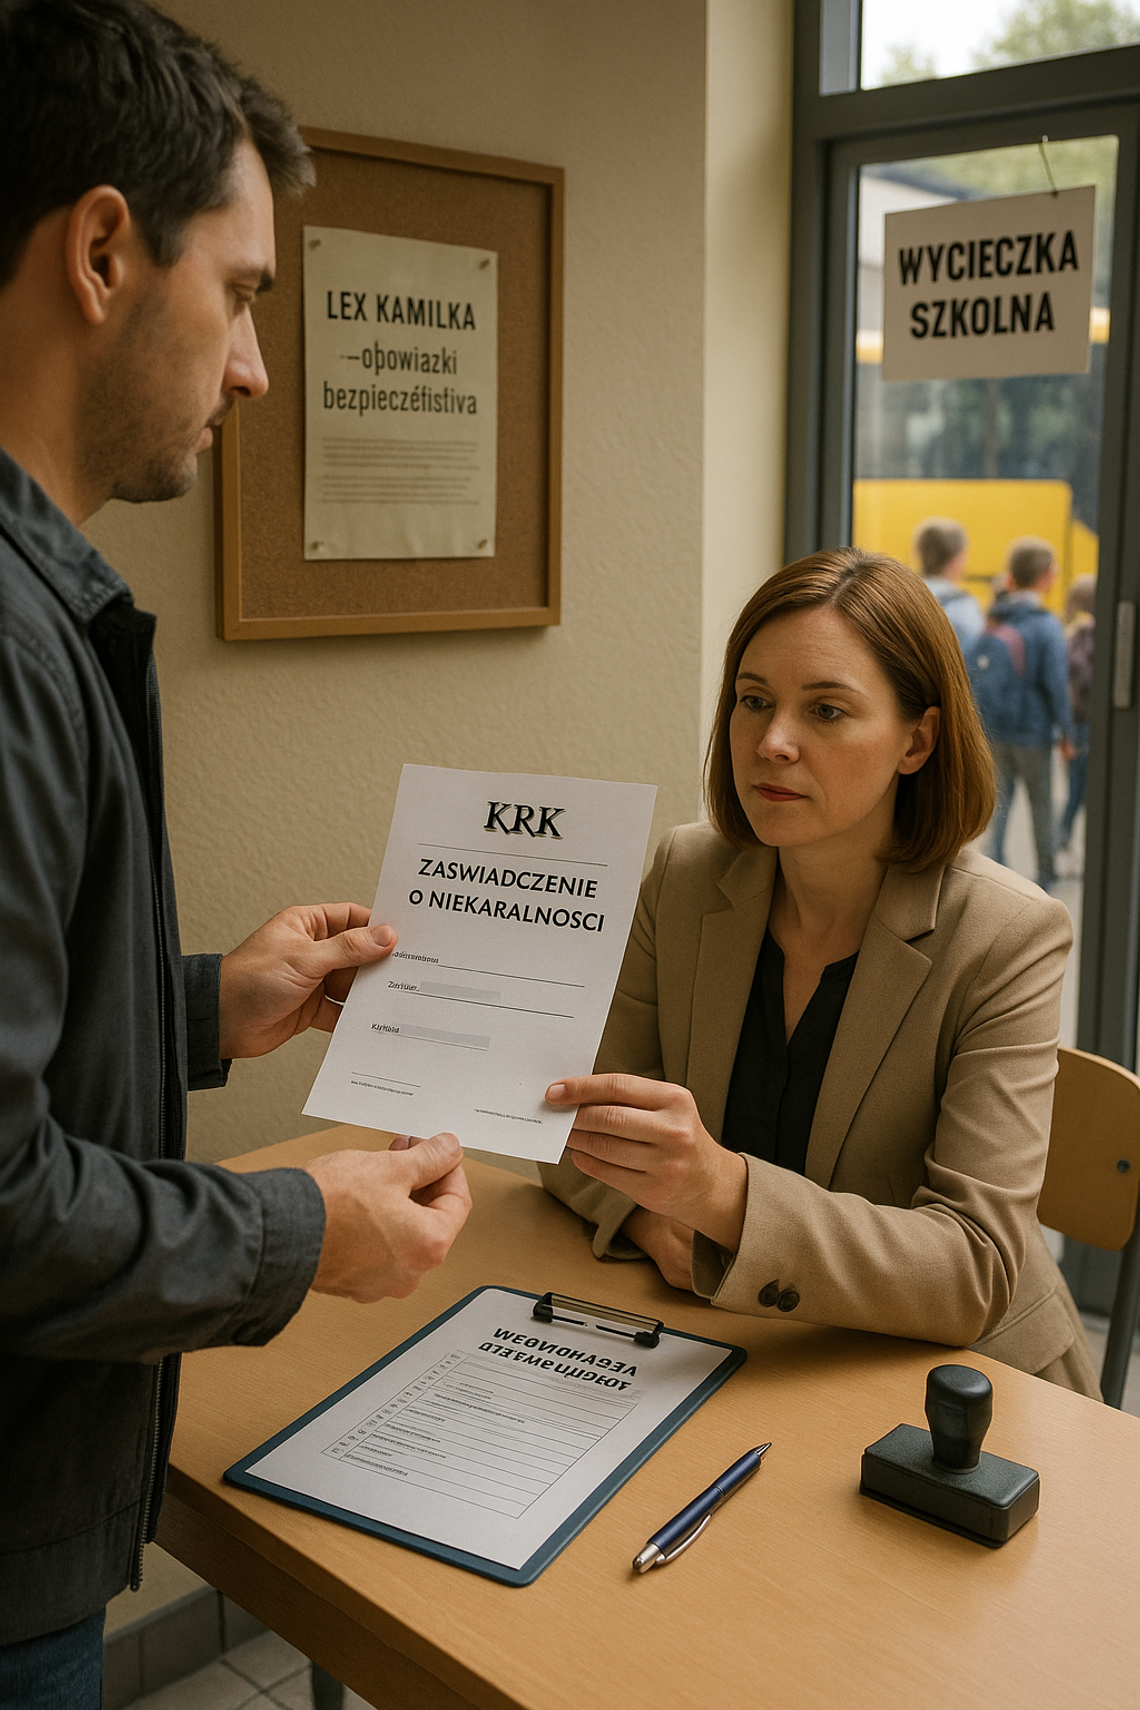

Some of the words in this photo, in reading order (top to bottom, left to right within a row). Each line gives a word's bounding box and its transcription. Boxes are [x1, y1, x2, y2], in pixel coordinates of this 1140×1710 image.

[898, 229, 1079, 286] WYCIECZKA
[327, 290, 368, 321] LEX
[376, 293, 477, 331] KAMILKA
[910, 291, 1055, 339] SZKOLNA
[483, 800, 566, 840] KRK
[418, 858, 598, 899] ZASWIADCZENIE
[409, 889, 424, 905] O
[428, 890, 605, 932] NIEKARALNOSCI
